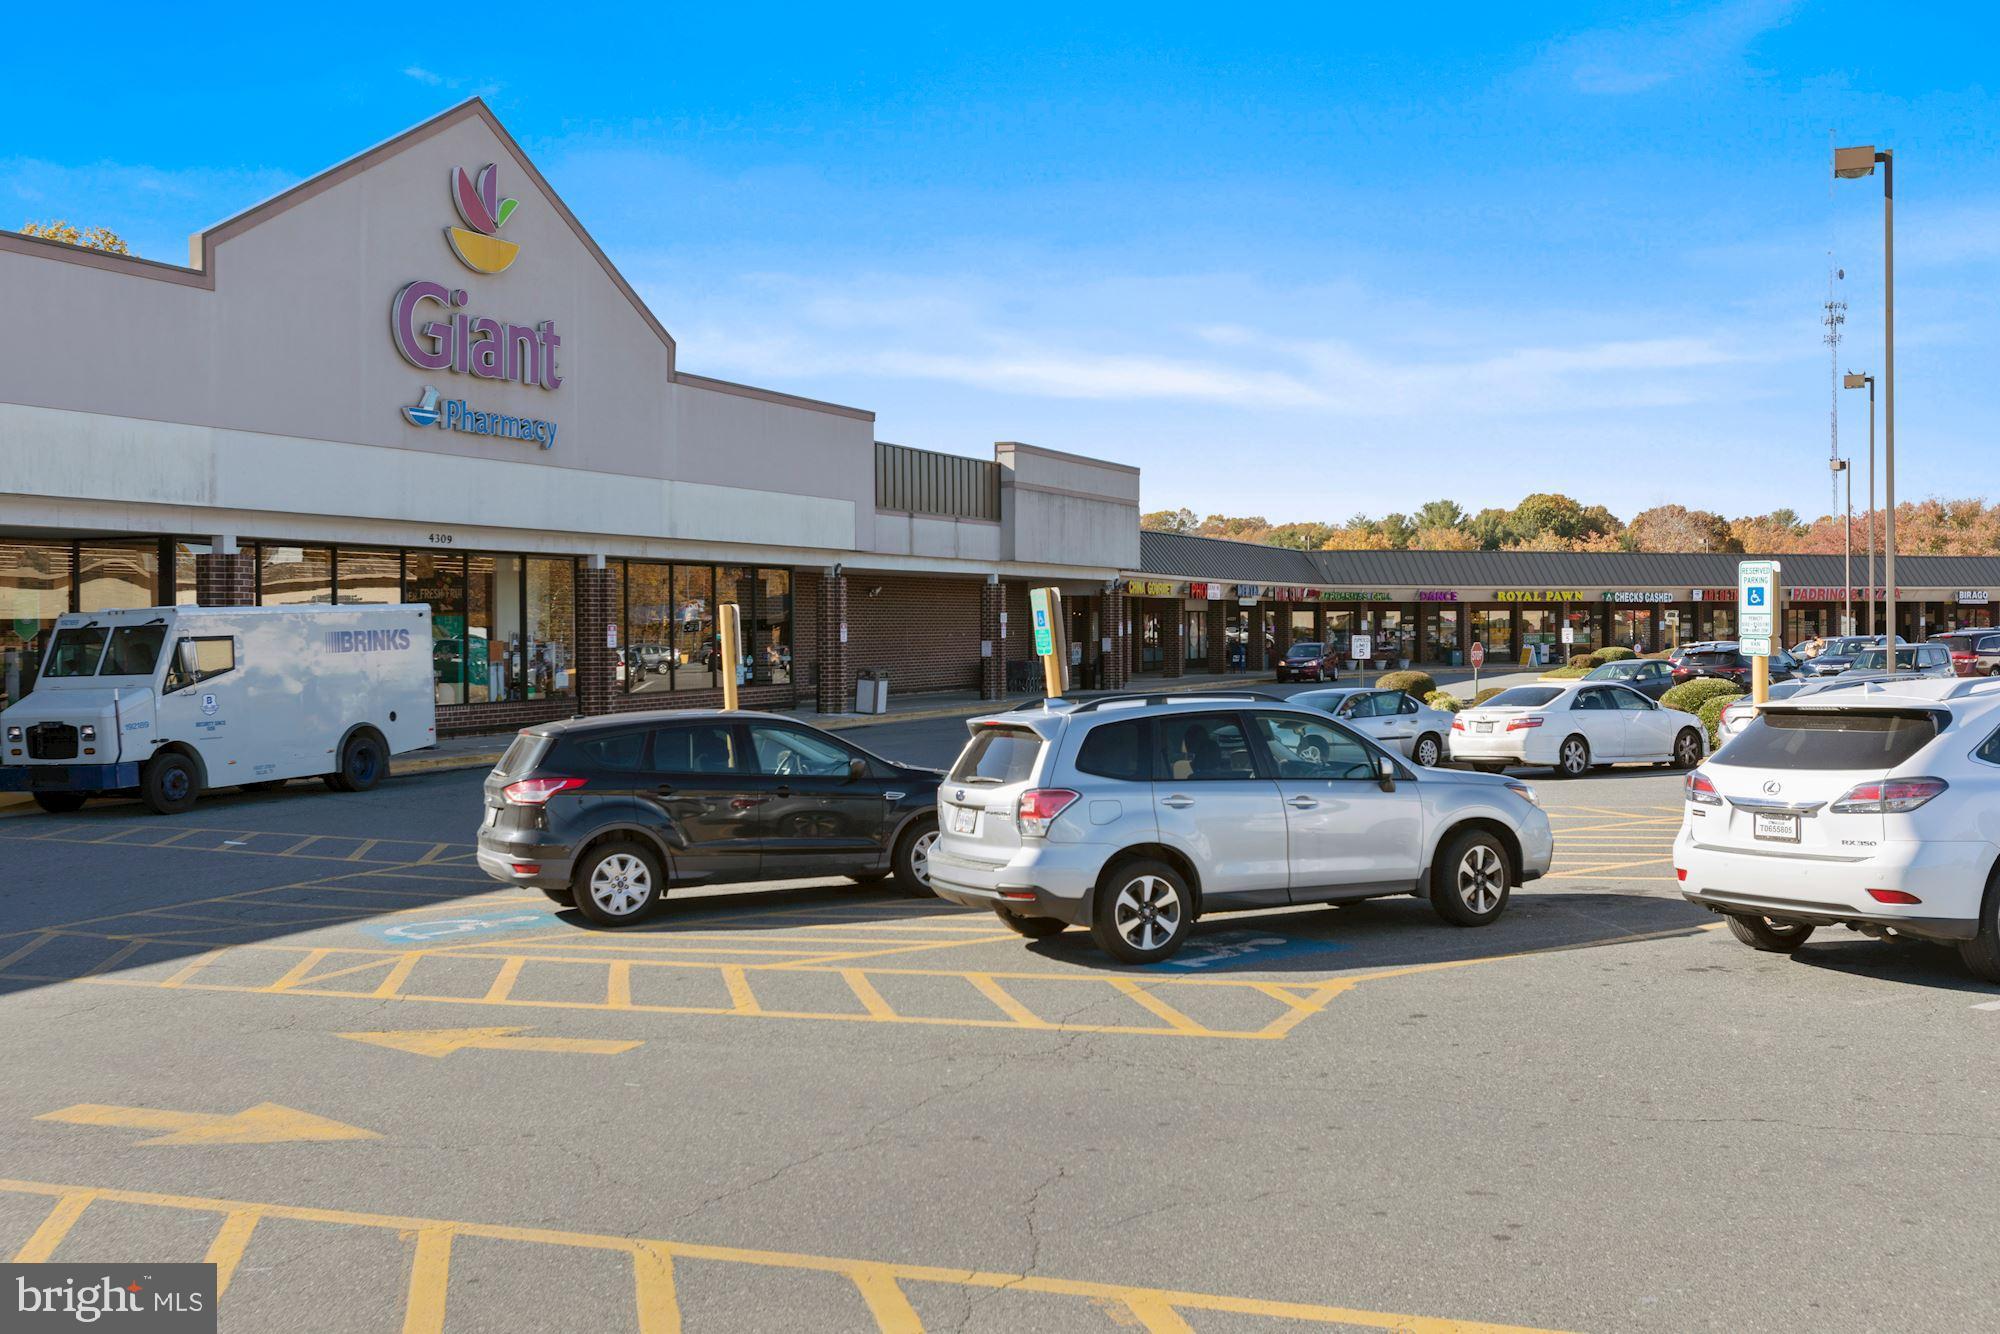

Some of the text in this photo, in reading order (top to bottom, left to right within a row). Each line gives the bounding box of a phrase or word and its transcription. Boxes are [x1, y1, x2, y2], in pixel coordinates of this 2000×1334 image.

[393, 281, 564, 390] Giant
[441, 400, 558, 449] Pharmacy
[428, 533, 453, 544] 4309
[1741, 567, 1770, 575] RESERVED
[1190, 583, 1207, 599] PHO
[1420, 591, 1457, 601] DANCE
[1497, 591, 1584, 601] ROYAL PAWN
[1793, 588, 1858, 600] PADRINOS
[1959, 591, 1988, 599] BIRAGO
[1614, 592, 1643, 603] CHECKS
[1645, 592, 1673, 603] CASHED
[338, 629, 410, 653] BRINKS
[1358, 648, 1365, 657] 5
[1471, 651, 1483, 661] STOP
[206, 696, 213, 705] B
